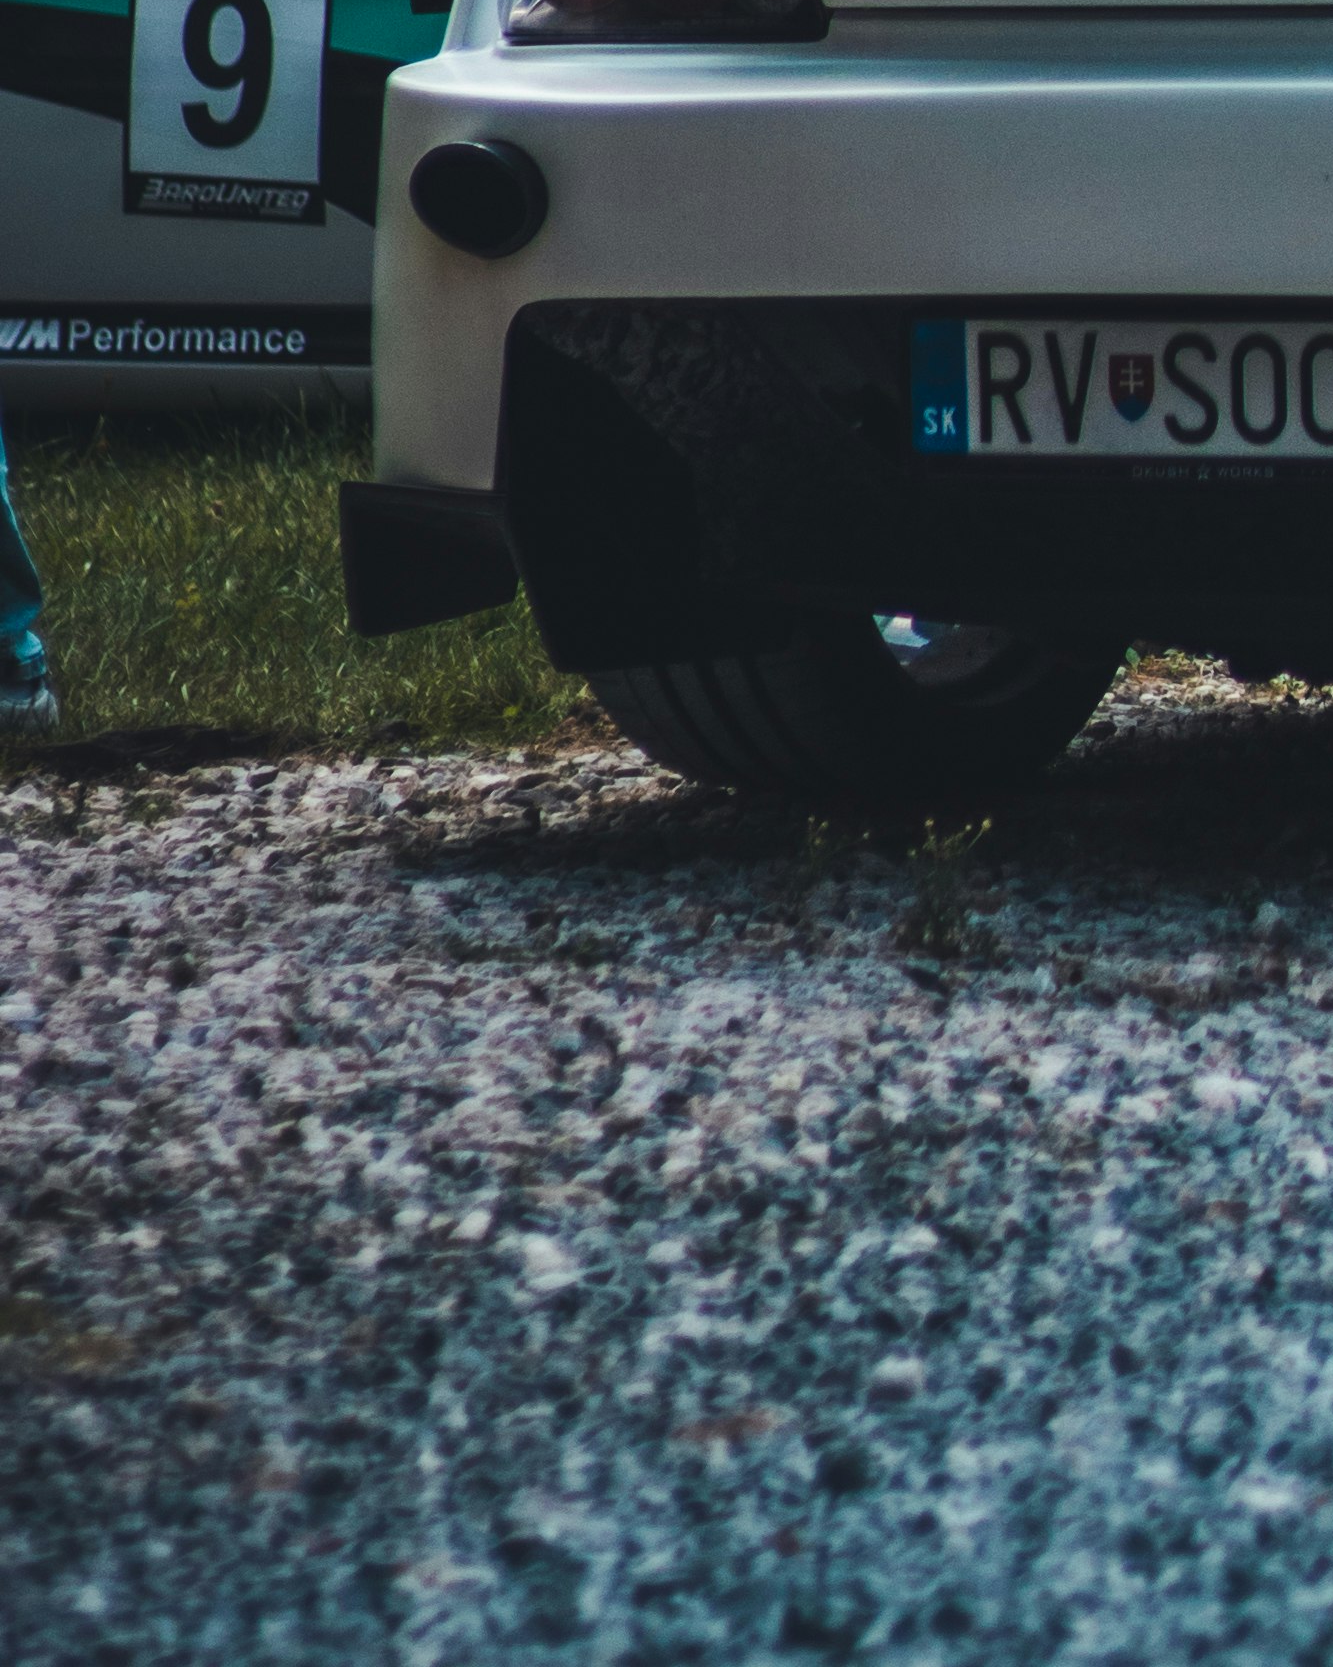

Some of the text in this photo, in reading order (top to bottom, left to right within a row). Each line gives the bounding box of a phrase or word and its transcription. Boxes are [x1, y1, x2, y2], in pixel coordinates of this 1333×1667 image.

[67, 318, 307, 355] Performance
[976, 330, 1099, 445] RV
[921, 406, 958, 436] SK
